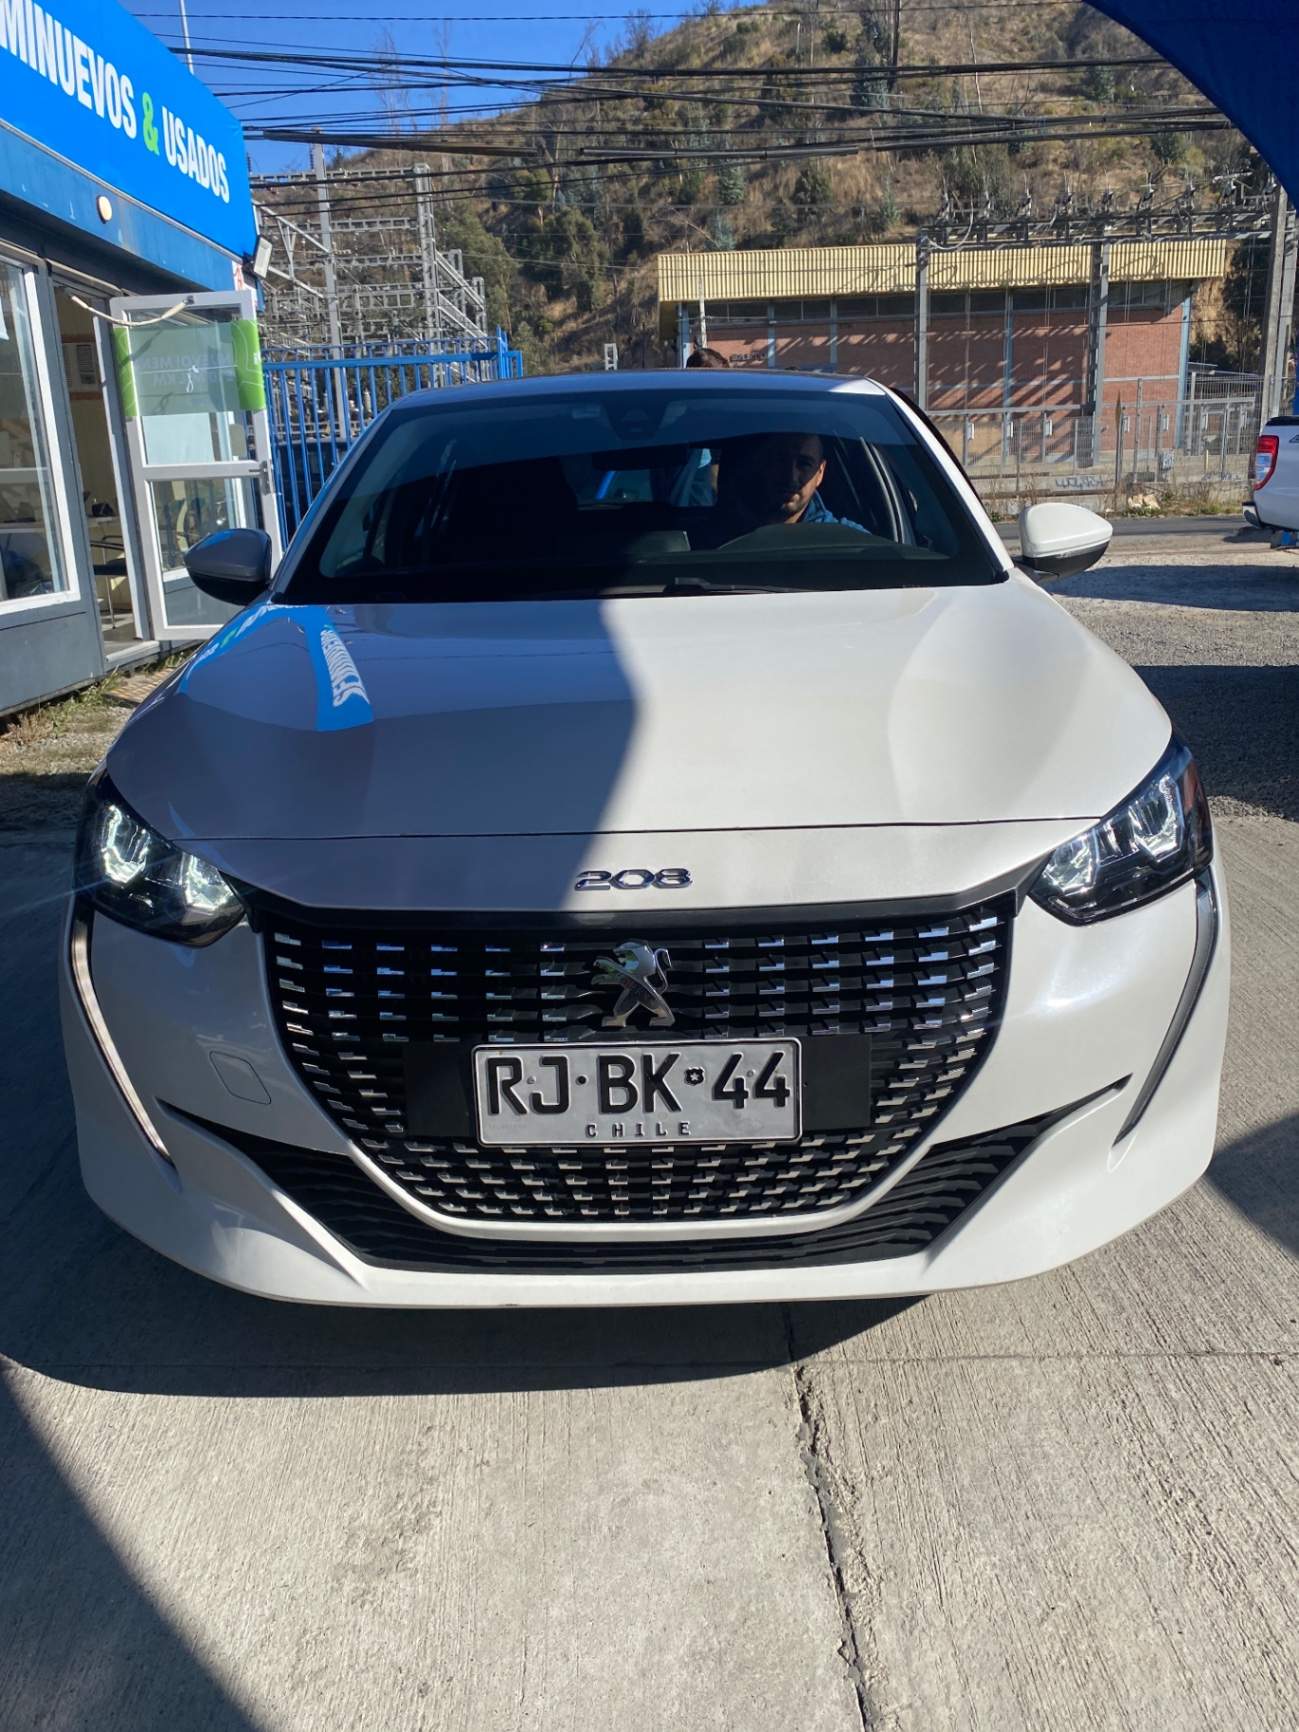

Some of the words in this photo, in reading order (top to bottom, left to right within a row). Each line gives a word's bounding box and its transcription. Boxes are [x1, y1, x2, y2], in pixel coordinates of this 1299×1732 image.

[142, 92, 160, 155] &
[162, 105, 230, 204] USADOS
[574, 868, 693, 891] 208
[586, 1121, 692, 1138] CHILE
